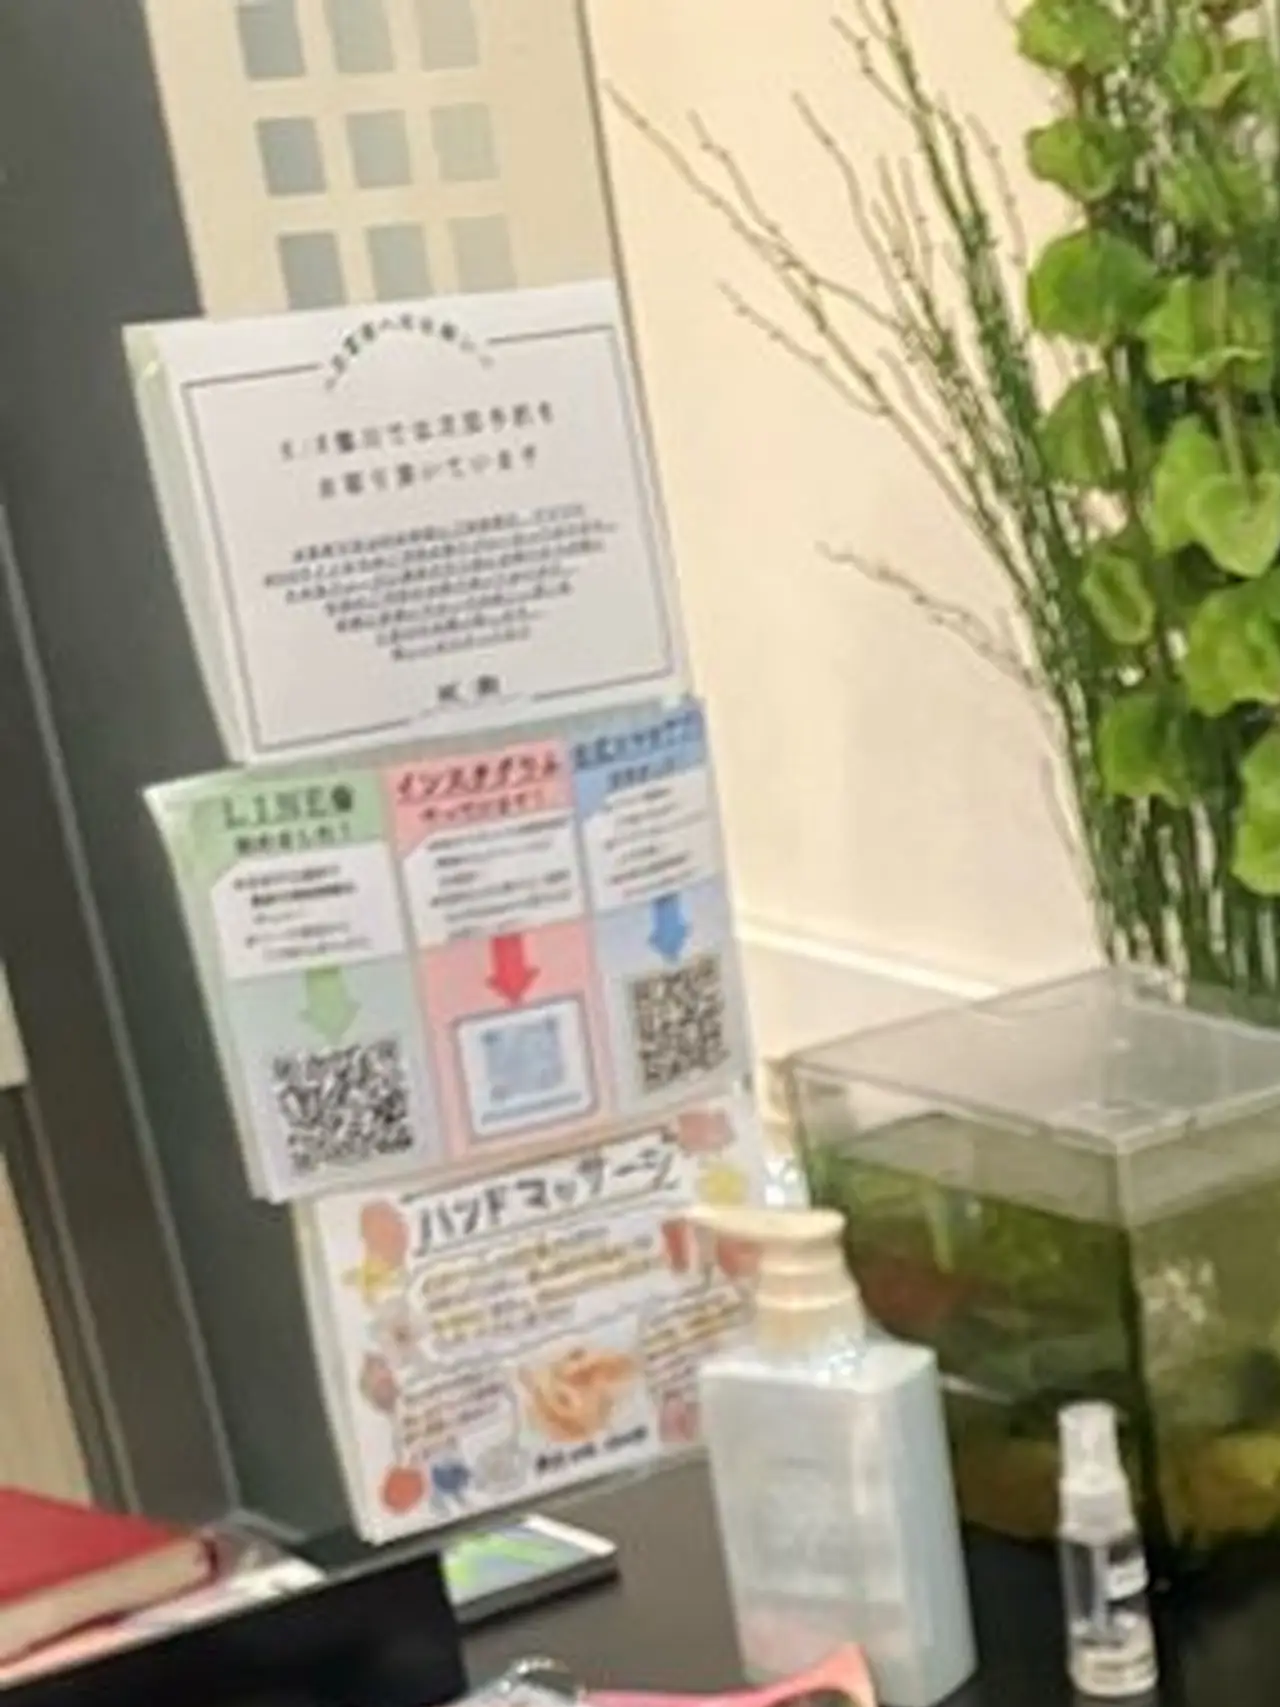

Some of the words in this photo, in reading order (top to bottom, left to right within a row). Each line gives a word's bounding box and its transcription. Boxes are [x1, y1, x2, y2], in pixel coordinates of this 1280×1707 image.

[414, 1145, 680, 1257] ハンドマッサージ
